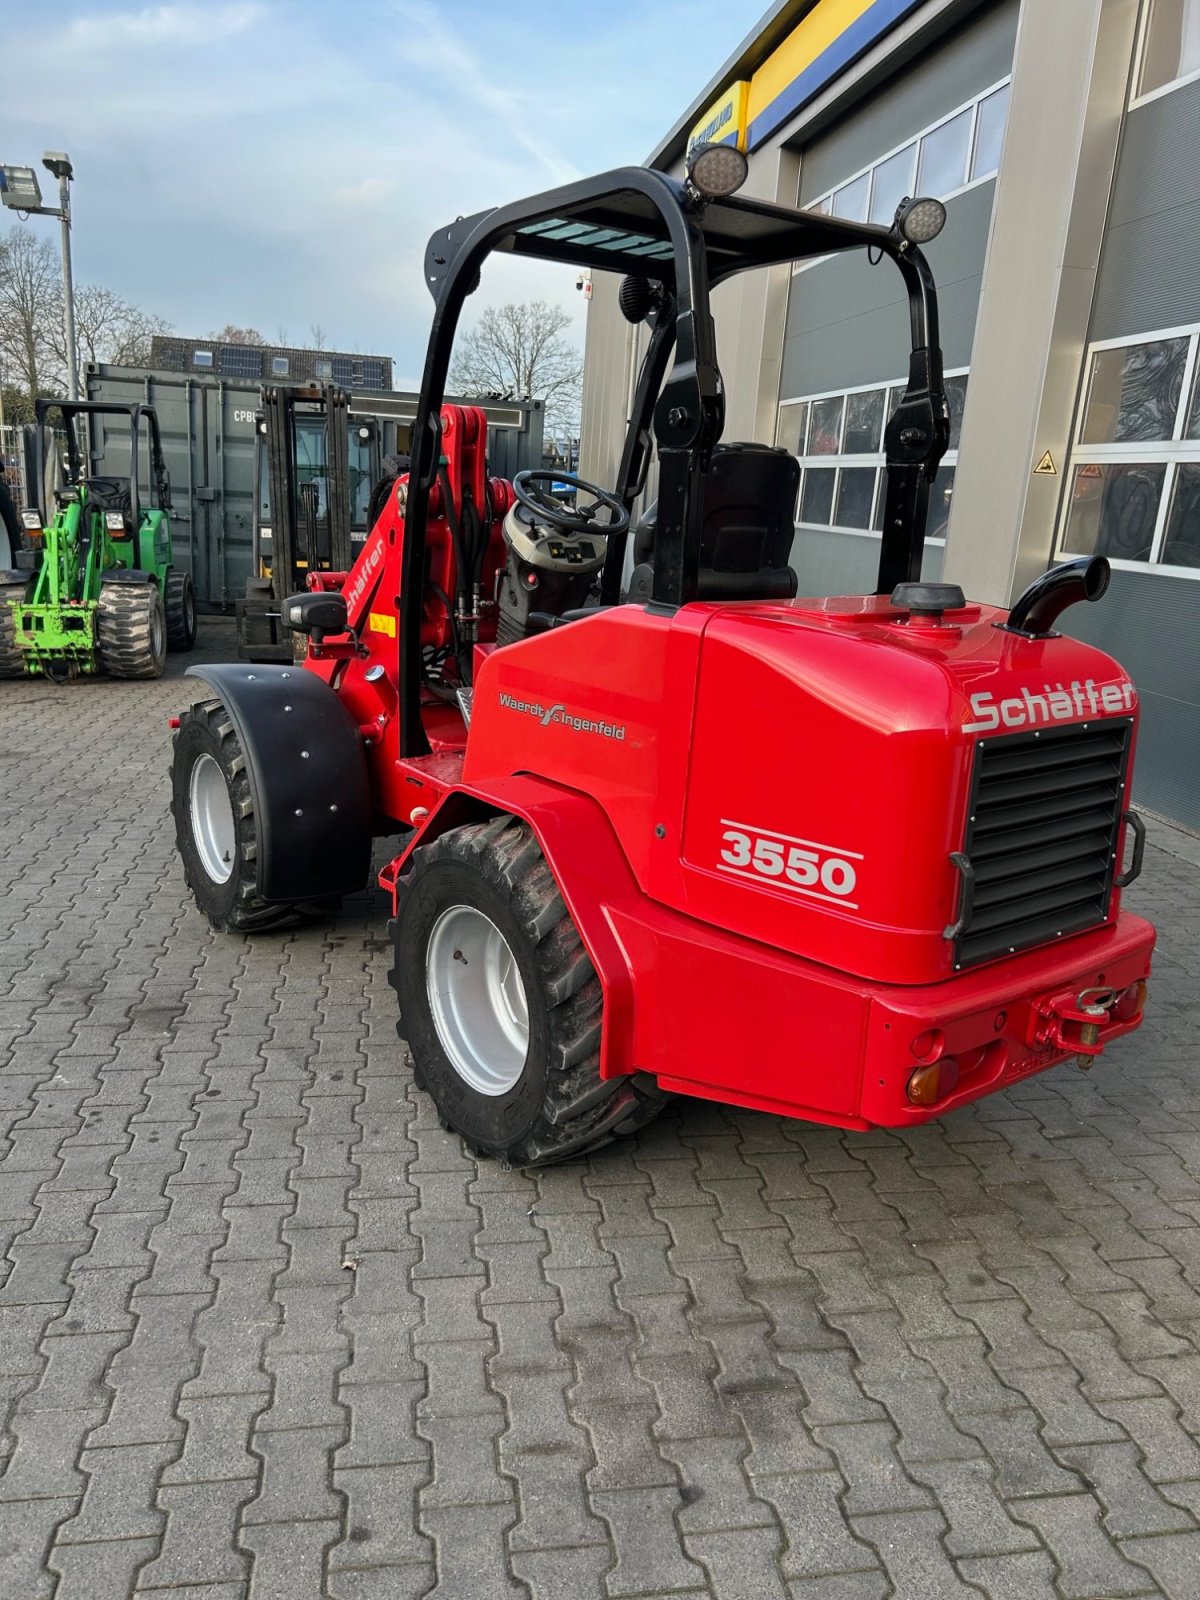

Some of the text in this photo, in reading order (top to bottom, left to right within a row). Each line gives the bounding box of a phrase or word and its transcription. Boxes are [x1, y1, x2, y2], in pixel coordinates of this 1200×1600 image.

[346, 539, 383, 617] chäffer
[499, 692, 545, 717] Waerdt
[561, 711, 625, 740] Ingenfeld
[961, 679, 1137, 734] Schäffer
[720, 830, 857, 896] 3550
